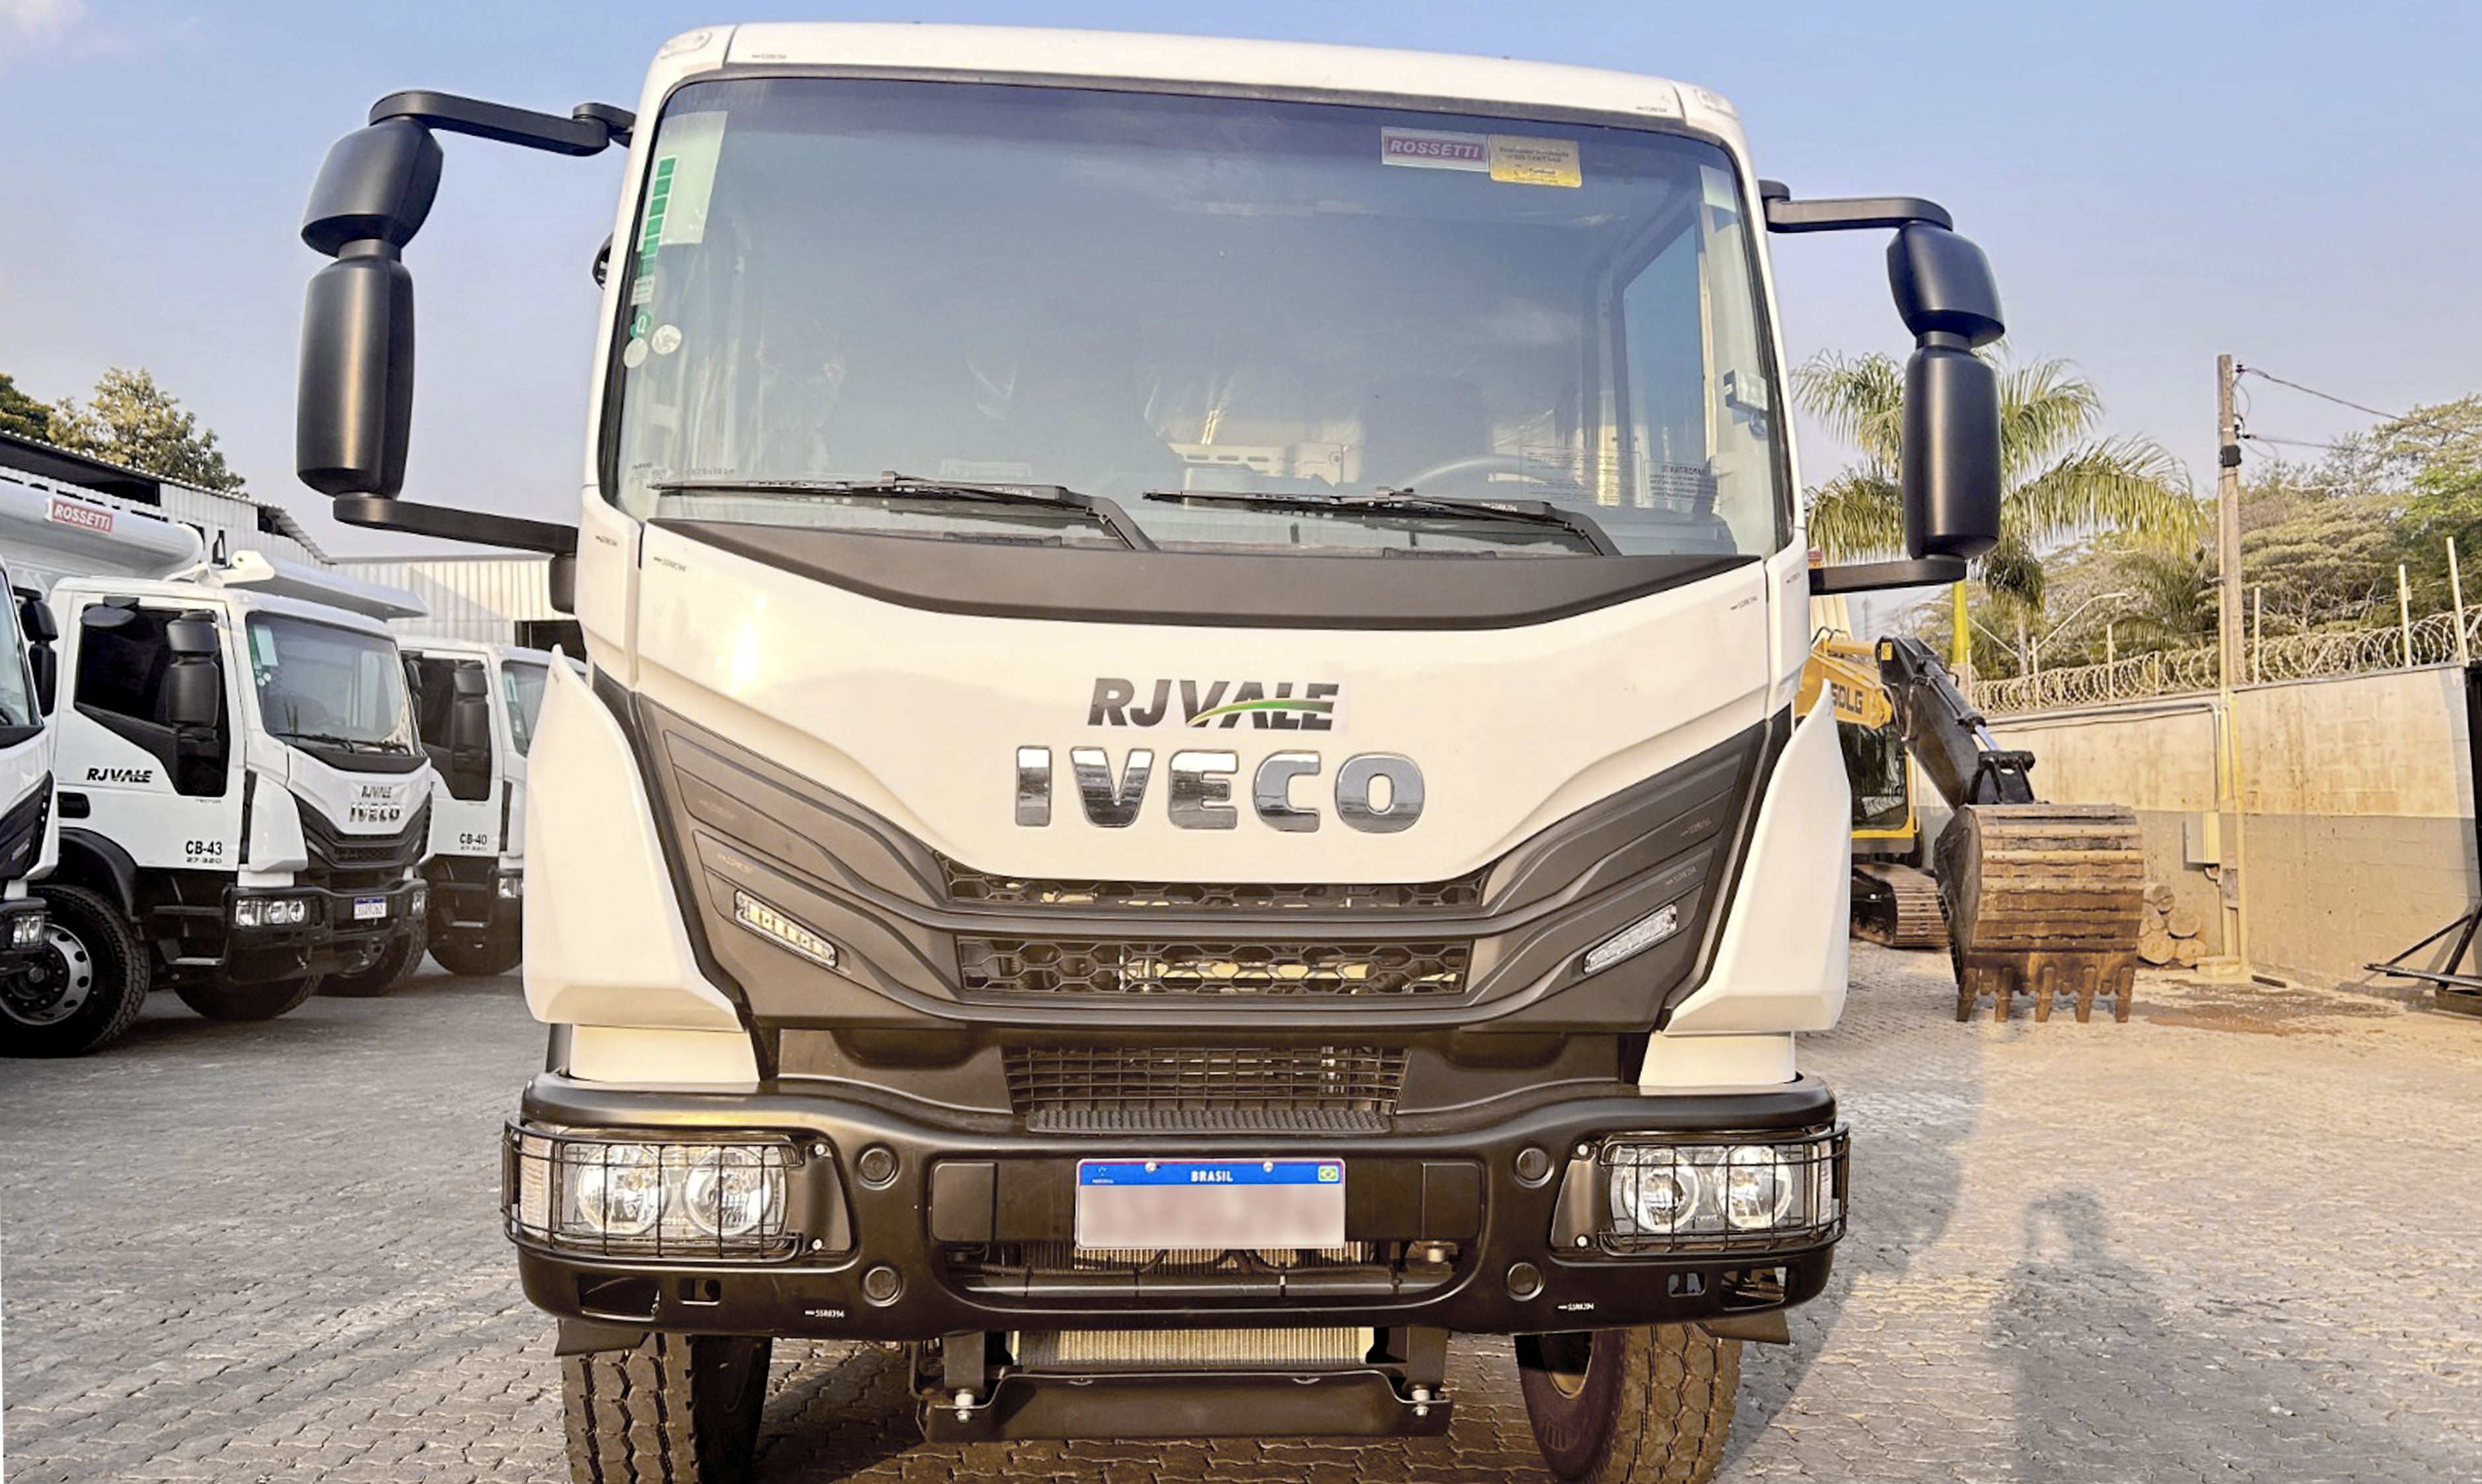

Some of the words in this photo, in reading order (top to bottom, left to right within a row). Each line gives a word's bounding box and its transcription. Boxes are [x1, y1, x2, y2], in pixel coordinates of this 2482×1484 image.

[1390, 140, 1480, 158] ROSSETTI
[54, 504, 111, 530] ROSSETTI
[1015, 746, 1425, 833] IVECO
[349, 802, 400, 822] IVECO
[186, 840, 222, 856] CB-43
[459, 833, 488, 845] CB-40
[1190, 1170, 1233, 1182] BRASIL
